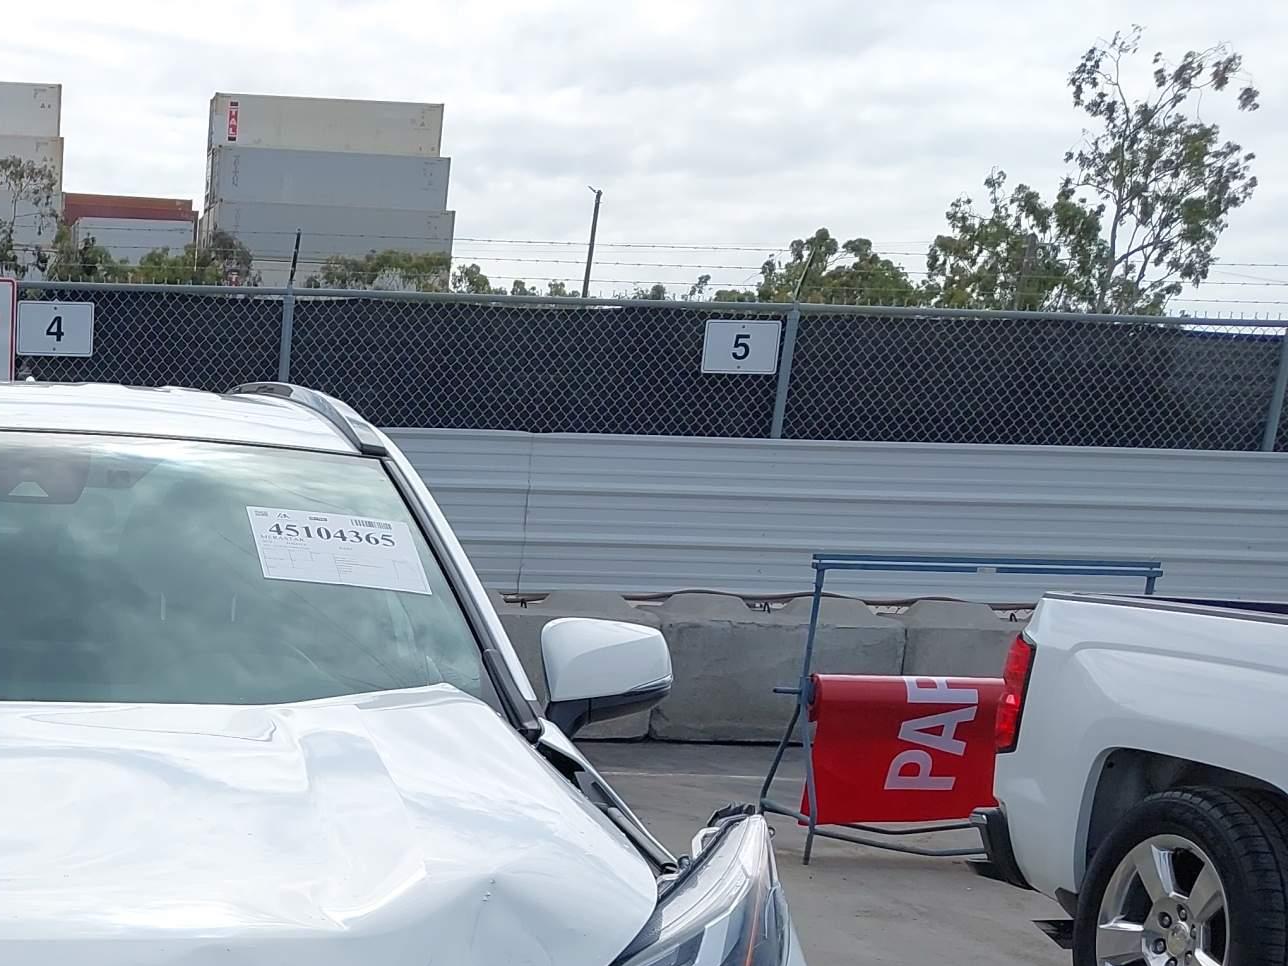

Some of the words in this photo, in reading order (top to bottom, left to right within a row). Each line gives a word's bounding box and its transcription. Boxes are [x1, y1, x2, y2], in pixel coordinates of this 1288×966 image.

[46, 315, 65, 342] 4
[732, 334, 751, 360] 5
[268, 522, 396, 548] 45104365
